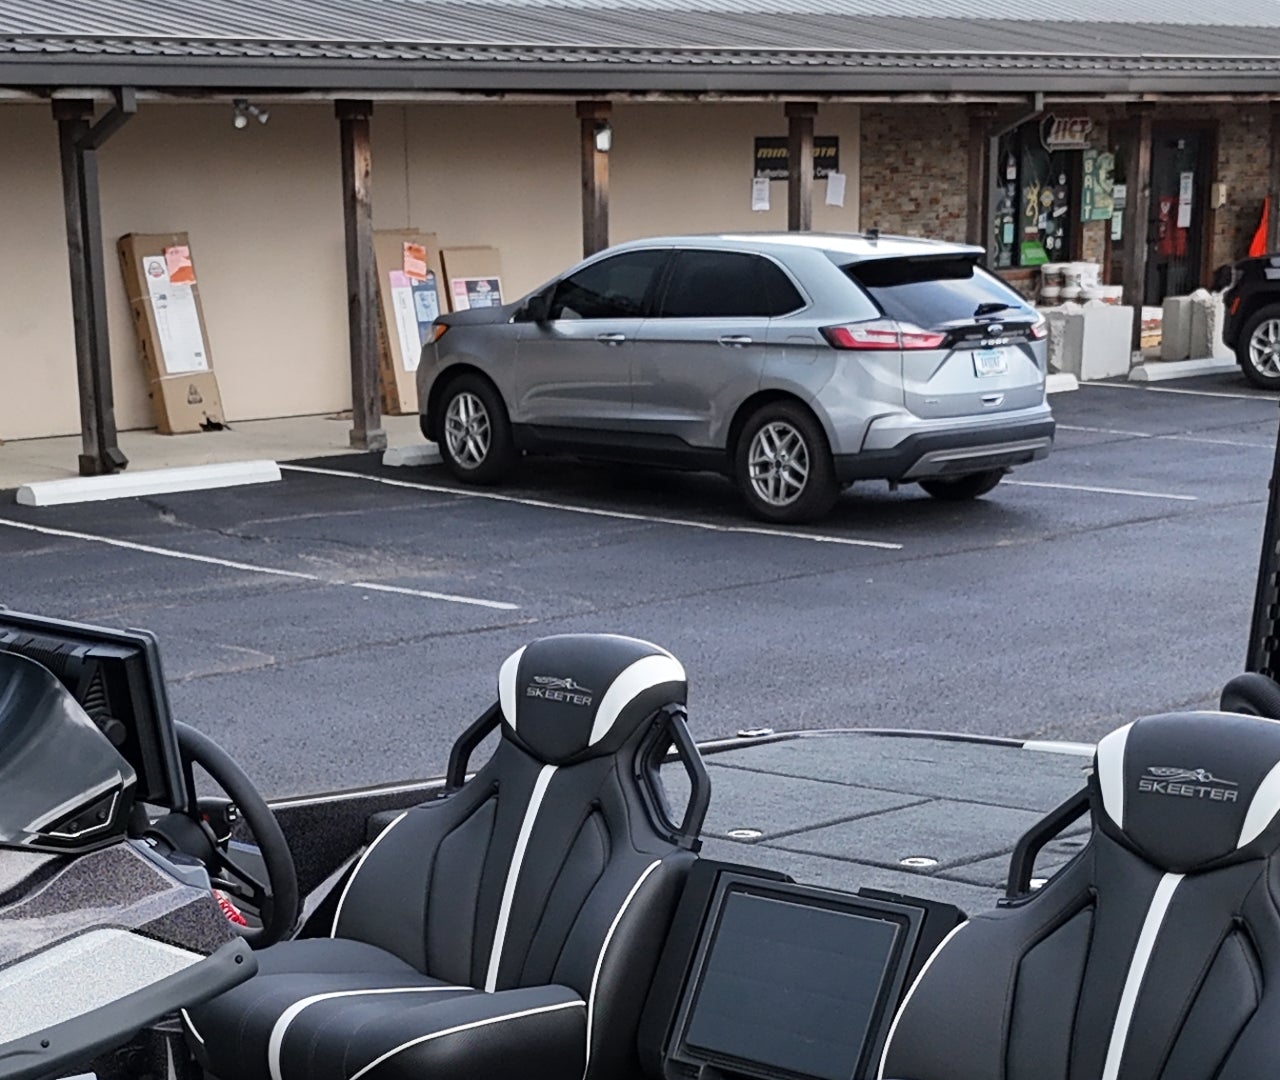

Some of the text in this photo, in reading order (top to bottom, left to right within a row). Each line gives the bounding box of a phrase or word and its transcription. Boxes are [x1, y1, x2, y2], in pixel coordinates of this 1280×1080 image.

[757, 148, 789, 158] MIN
[1084, 159, 1094, 220] BAIT
[526, 687, 593, 706] SKEETER
[1138, 779, 1238, 802] SKEETER
